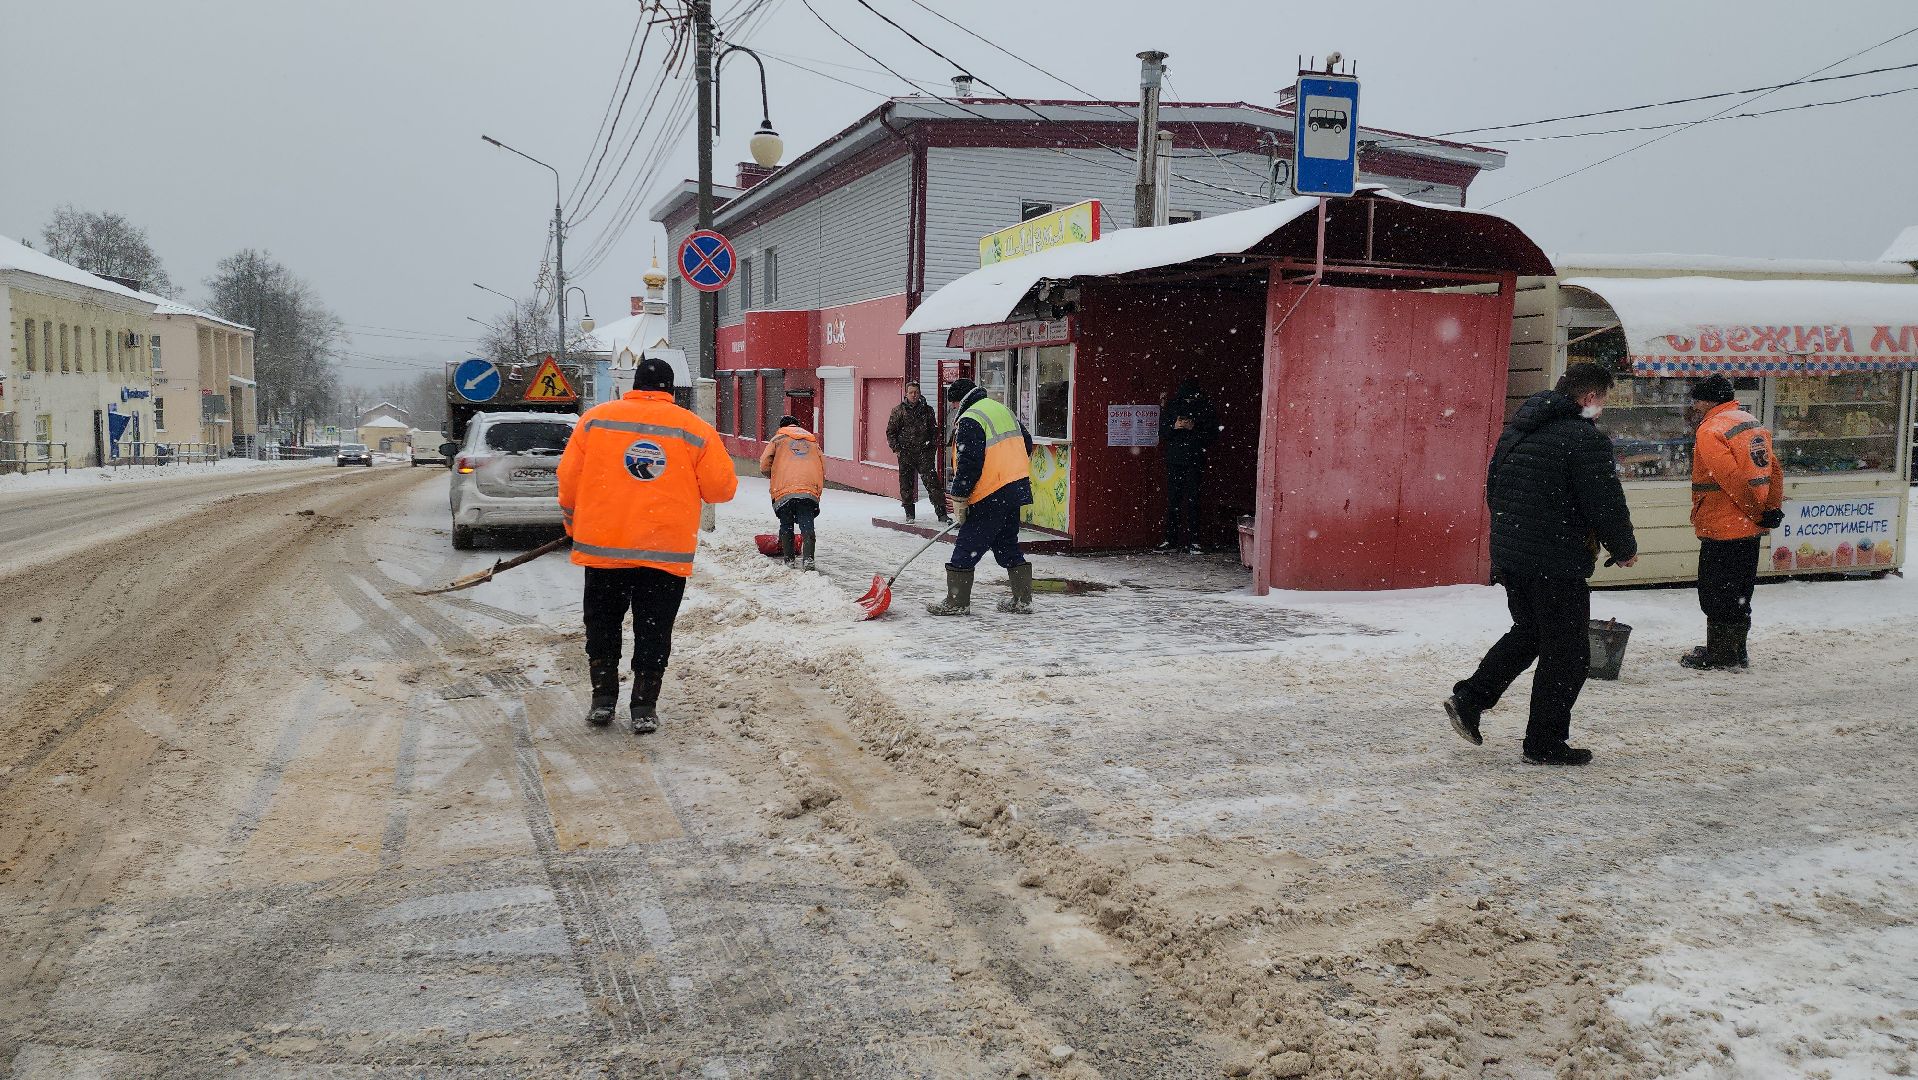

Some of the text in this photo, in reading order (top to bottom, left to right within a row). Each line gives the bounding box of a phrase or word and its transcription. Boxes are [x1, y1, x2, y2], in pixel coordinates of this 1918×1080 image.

[1800, 502, 1875, 518] МОРОЖЕНОЕ
[1784, 519, 1888, 537] В АССОРТИМЕНТЕ
